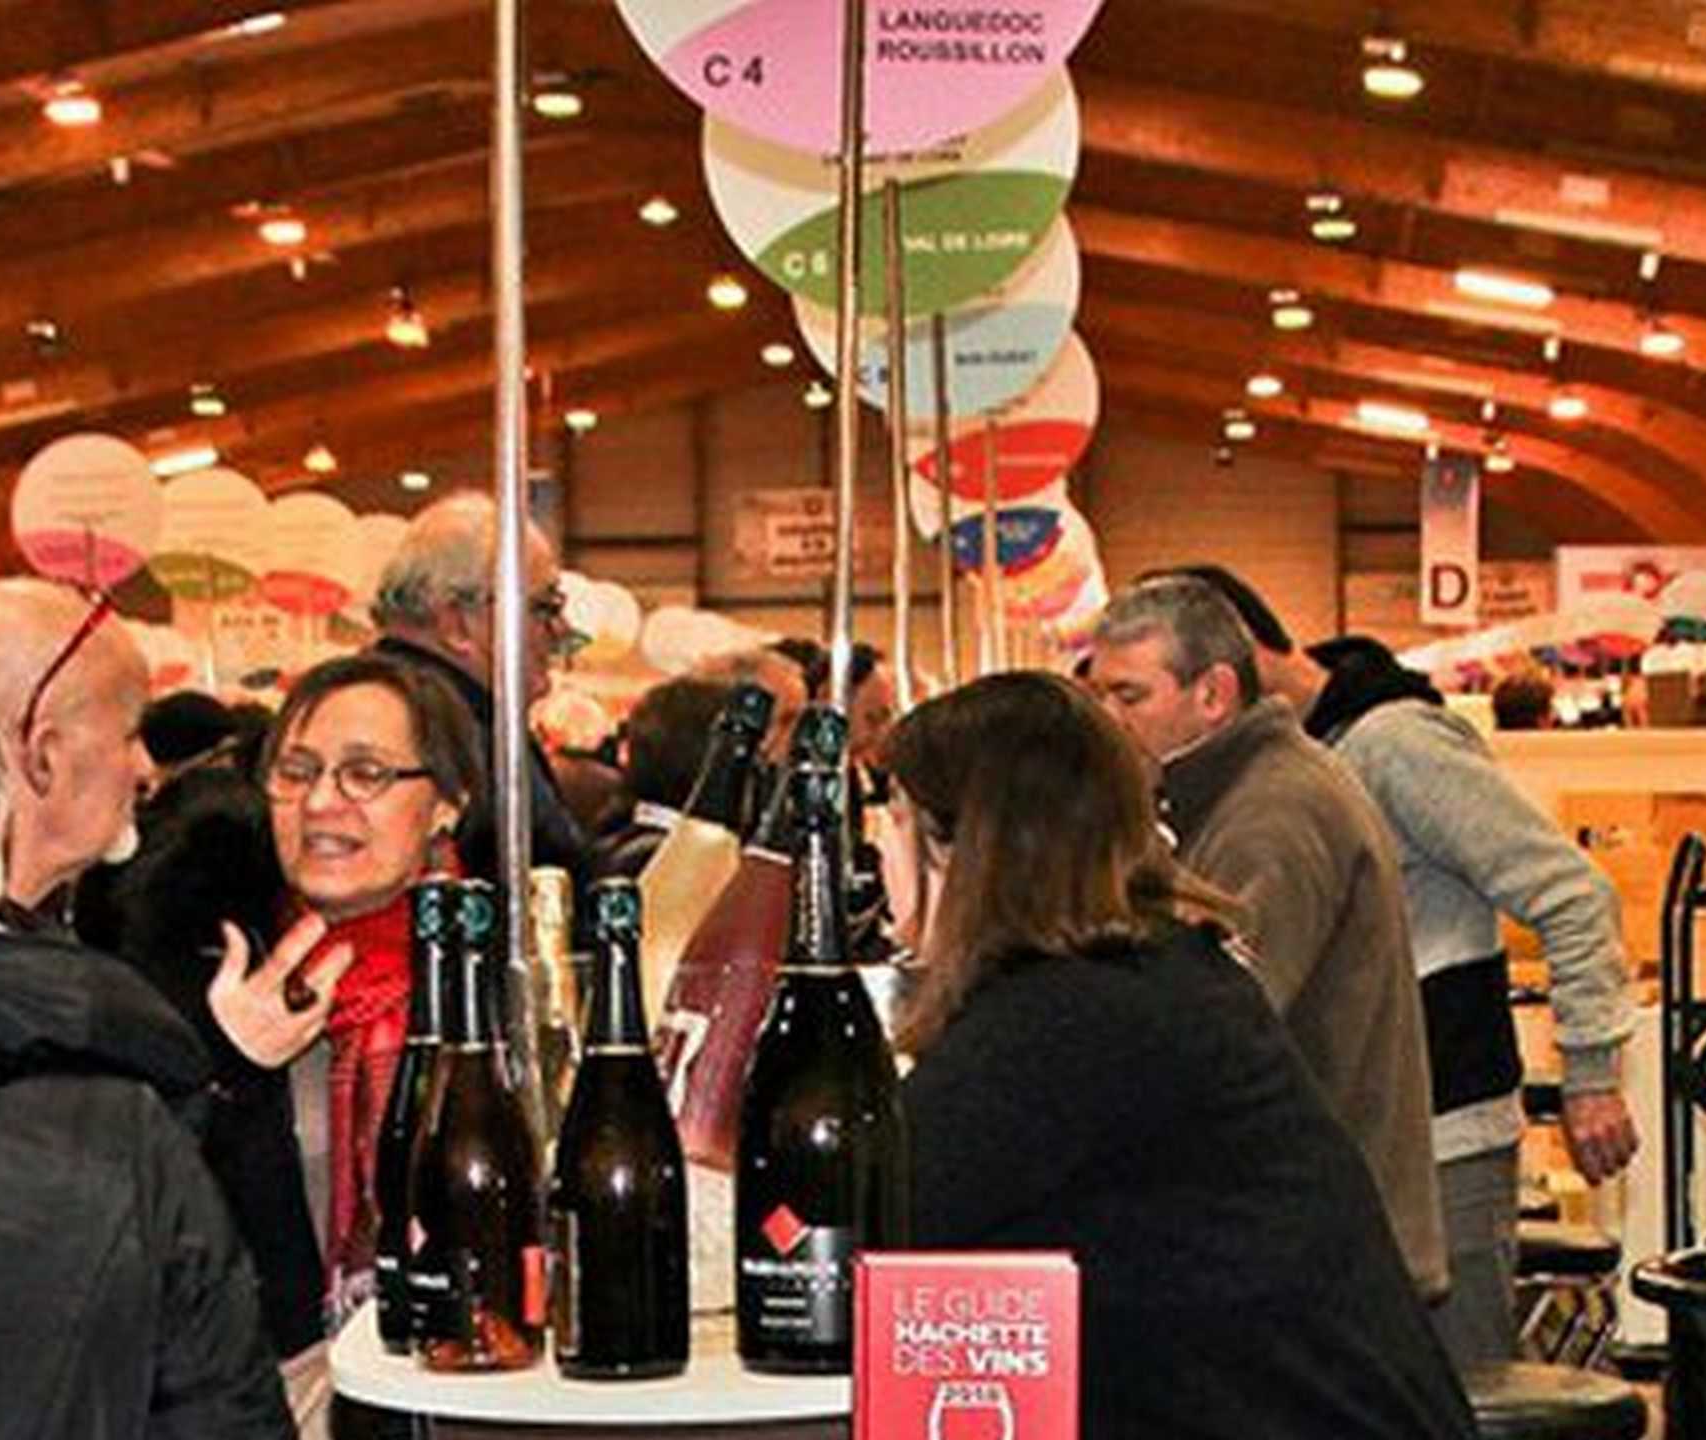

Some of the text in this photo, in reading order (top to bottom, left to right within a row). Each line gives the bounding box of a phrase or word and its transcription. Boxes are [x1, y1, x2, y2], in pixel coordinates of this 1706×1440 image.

[879, 11, 1044, 36] LANGUEDOC
[875, 40, 1046, 64] ROUSSILLON
[702, 55, 766, 88] C 4
[903, 230, 1032, 254] VAL DE LOIRE
[782, 251, 805, 278] C
[1429, 563, 1470, 610] D
[892, 1283, 1045, 1321] LE GUIDE
[894, 1320, 1051, 1348] HACHETTE
[895, 1347, 1048, 1376] DES VINS
